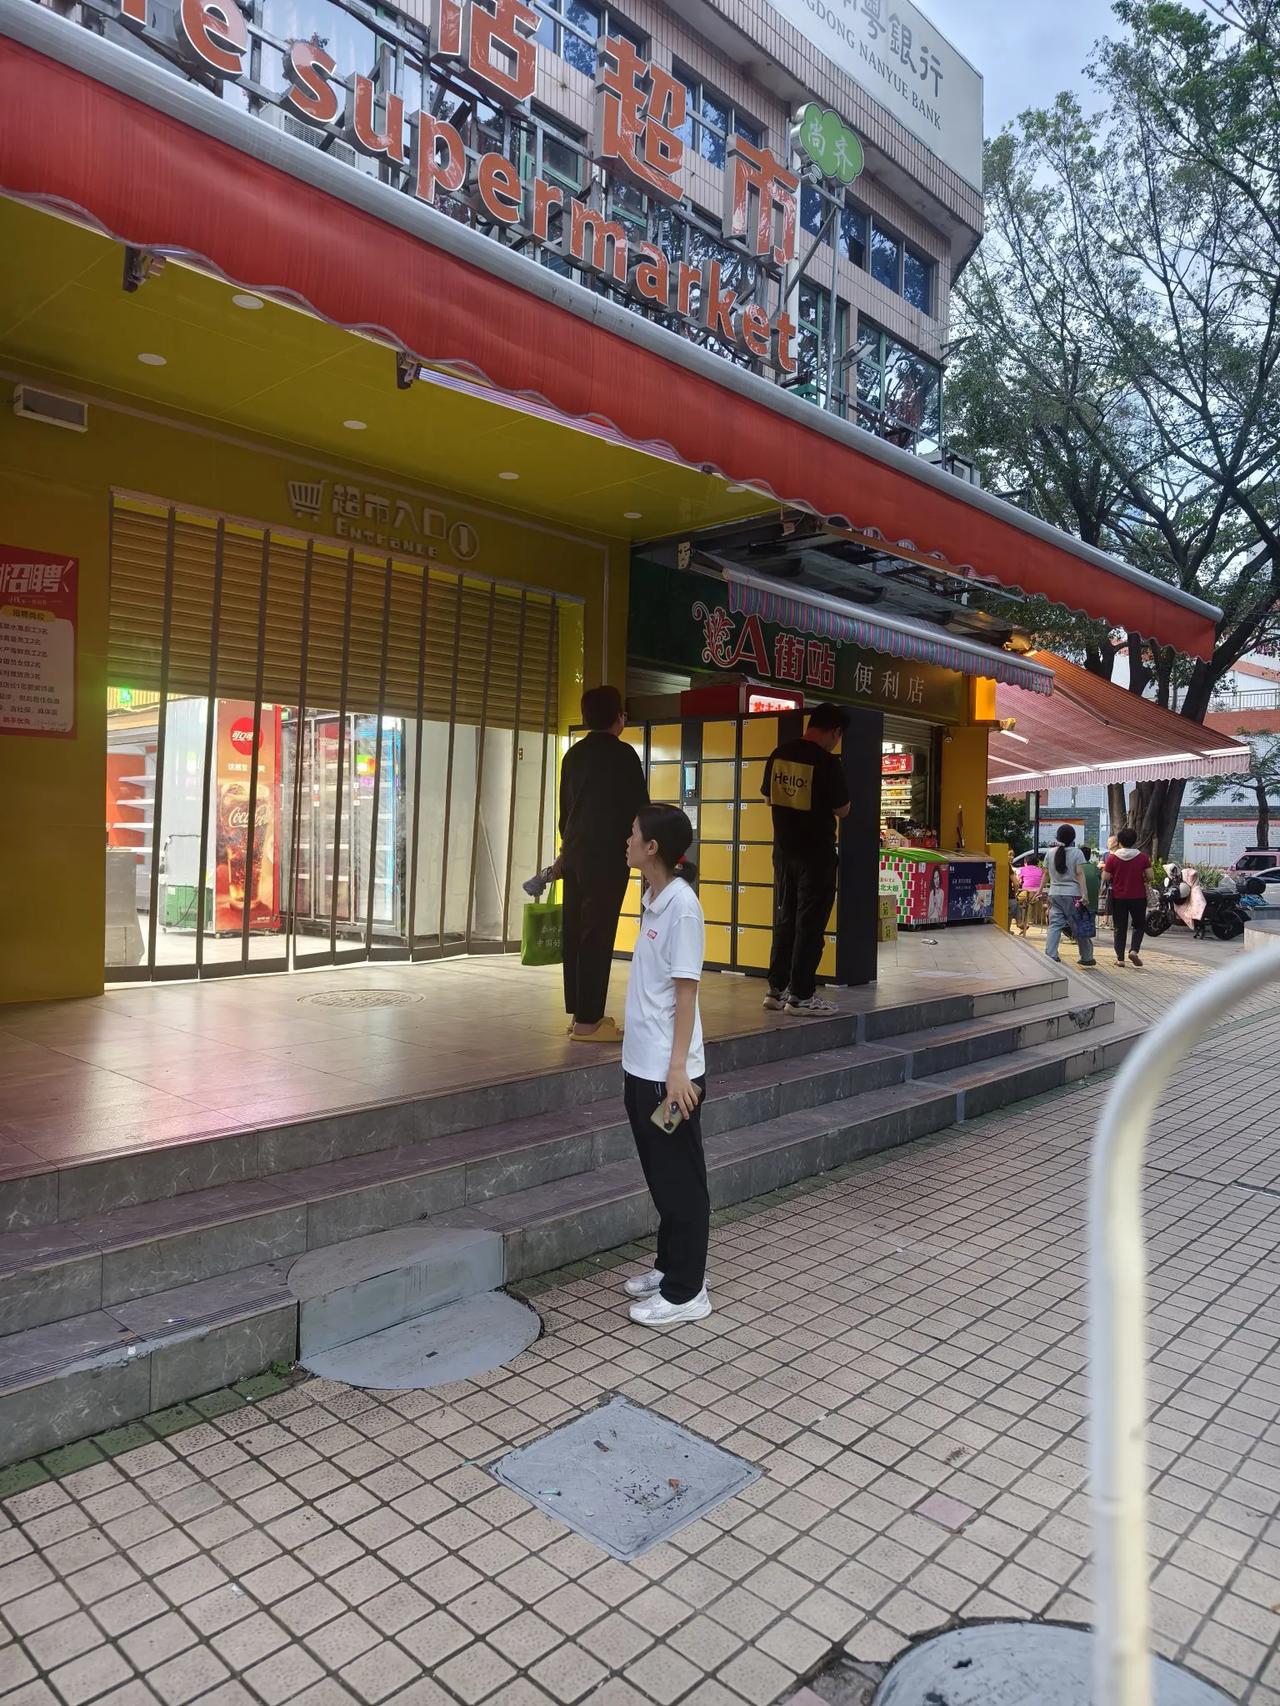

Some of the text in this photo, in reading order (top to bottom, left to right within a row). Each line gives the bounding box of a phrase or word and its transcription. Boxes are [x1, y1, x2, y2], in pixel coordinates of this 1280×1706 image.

[859, 39, 908, 100] NANYUE
[911, 90, 942, 131] BANK
[287, 42, 798, 374] supermarket
[332, 483, 447, 540] 超市入口
[853, 661, 926, 704] 便利店
